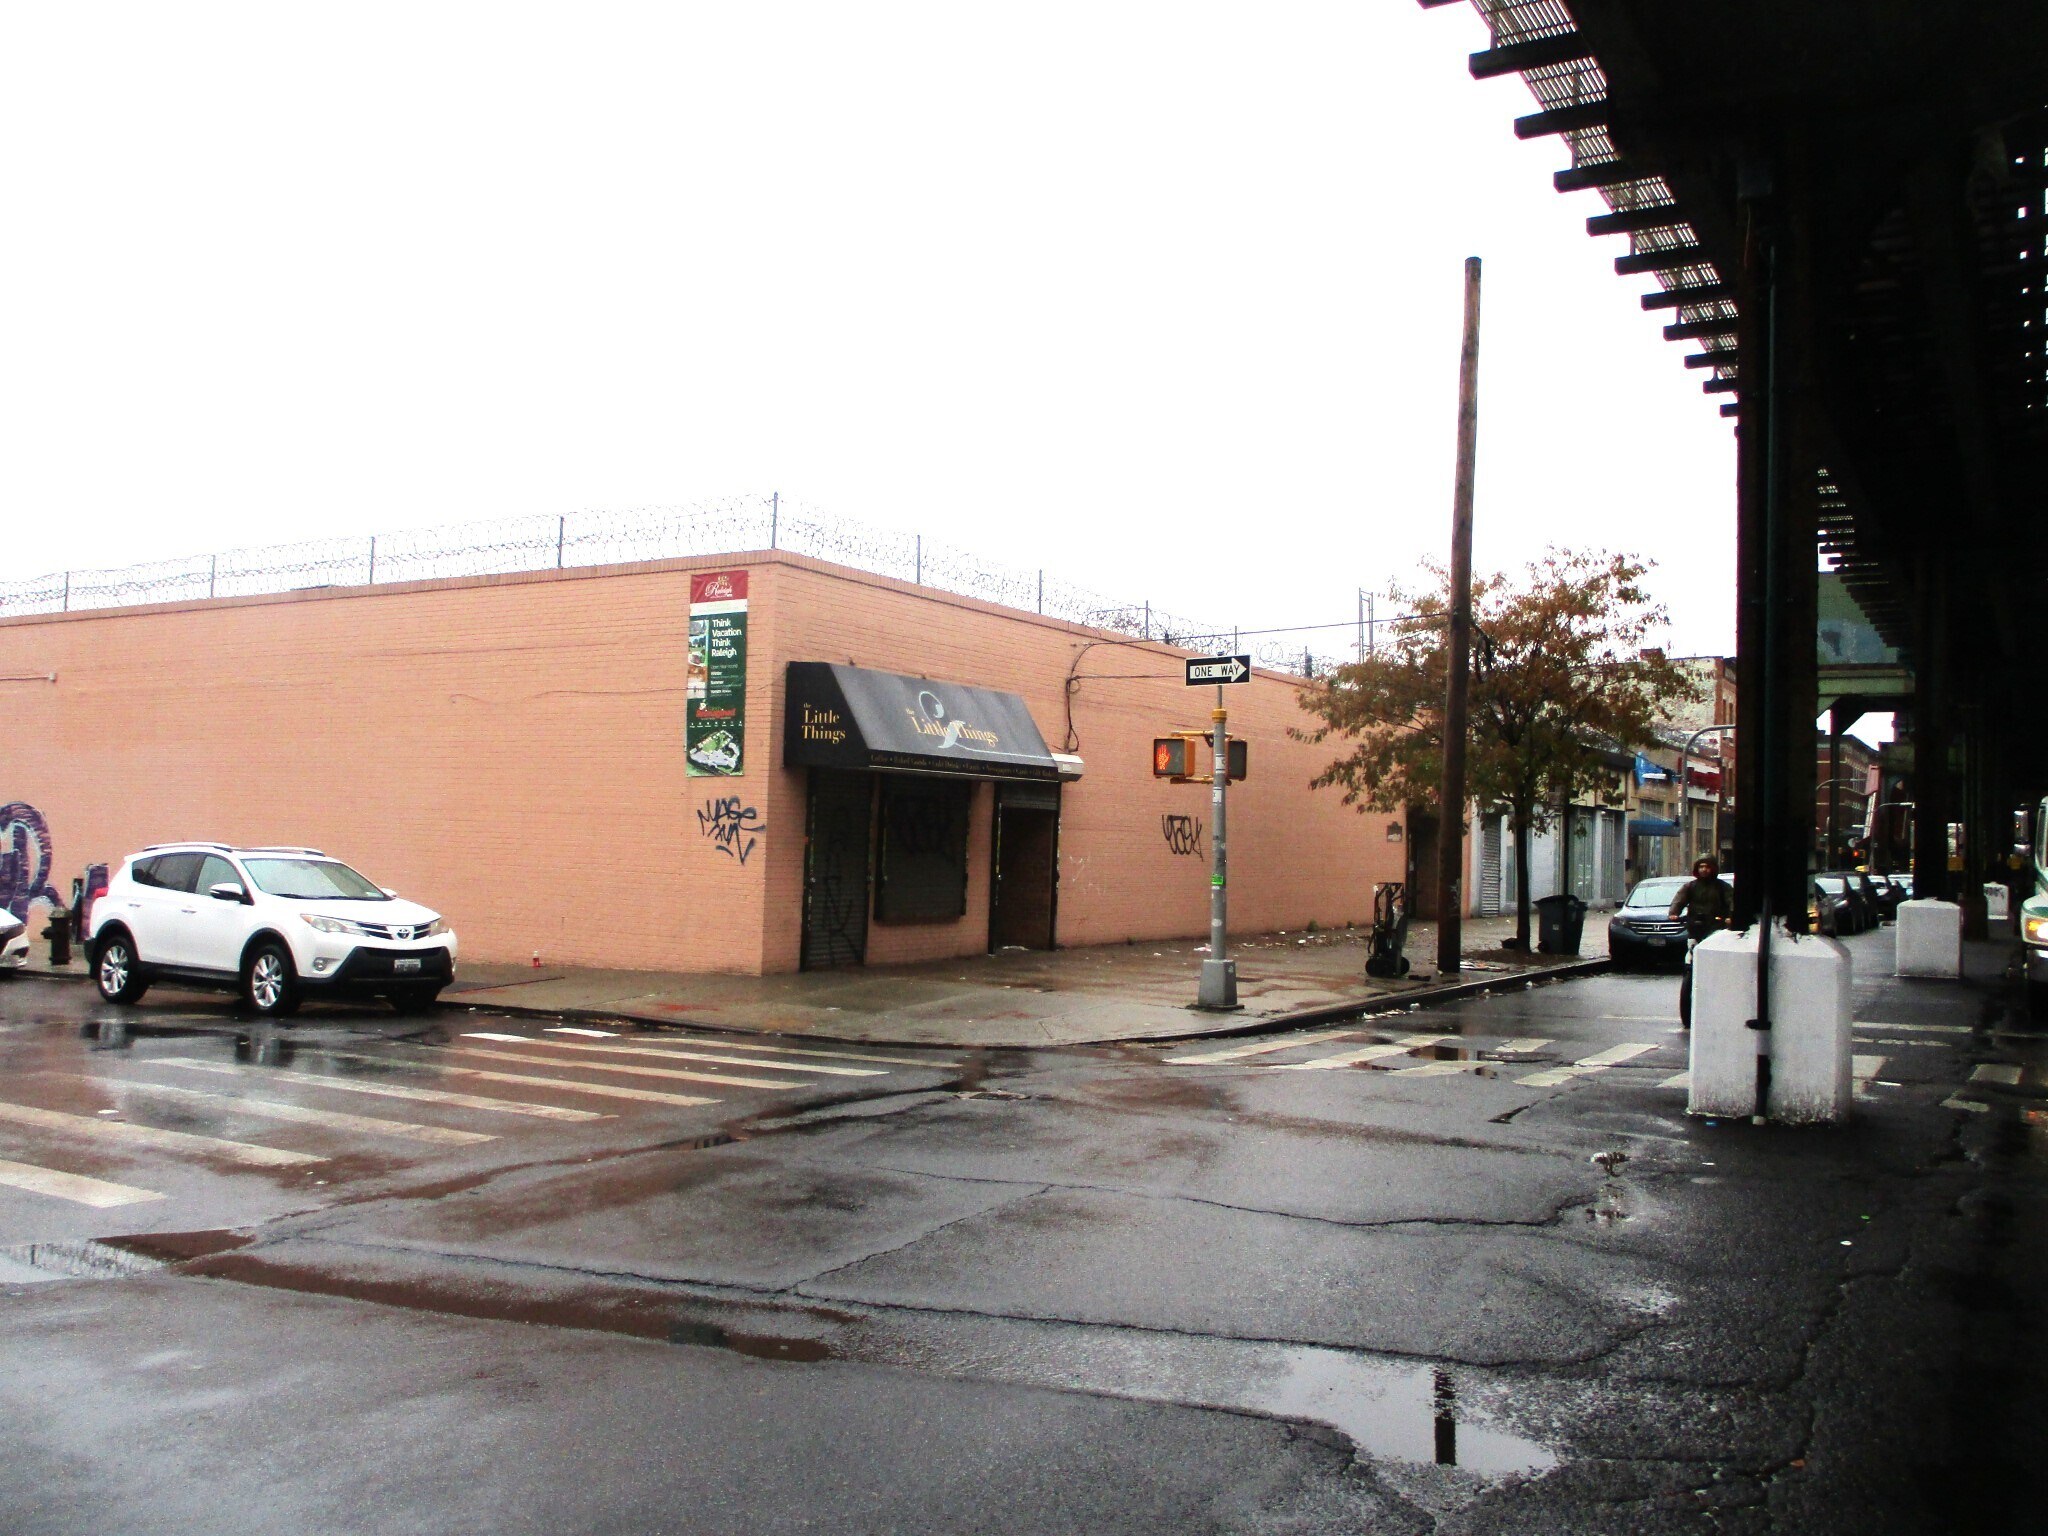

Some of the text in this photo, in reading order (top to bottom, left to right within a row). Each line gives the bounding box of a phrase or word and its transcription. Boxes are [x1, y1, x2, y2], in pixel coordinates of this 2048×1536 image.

[712, 618, 731, 627] Think
[712, 628, 742, 638] Vacation
[712, 638, 731, 647] Think
[711, 648, 737, 658] Raleigh
[1194, 664, 1240, 677] ONE WAY
[804, 709, 840, 724] Little
[801, 725, 847, 745] Things
[911, 716, 999, 748] Little Things
